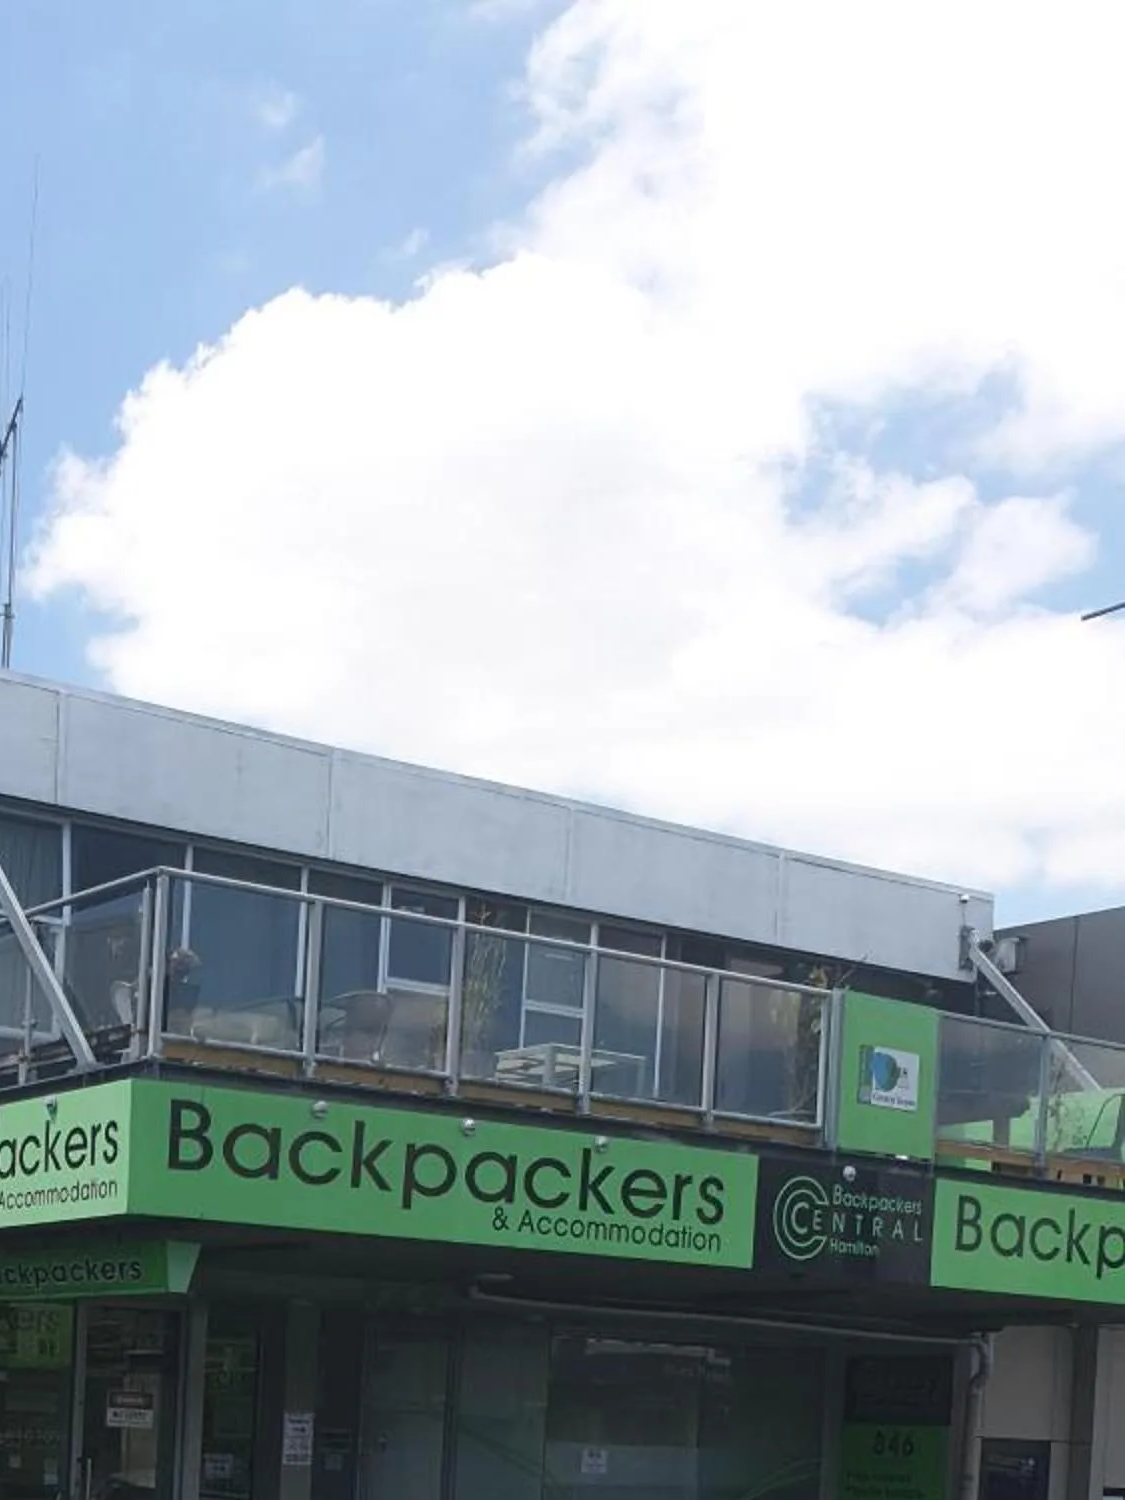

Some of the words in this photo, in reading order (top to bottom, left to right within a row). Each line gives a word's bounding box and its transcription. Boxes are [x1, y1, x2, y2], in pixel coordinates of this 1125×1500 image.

[167, 1099, 725, 1225] Backpackers
[790, 1201, 924, 1242] CENTRAL
[832, 1183, 923, 1215] Backpackers
[492, 1208, 509, 1231] &
[518, 1210, 721, 1253] Accommodation
[955, 1194, 1125, 1280] Backp
